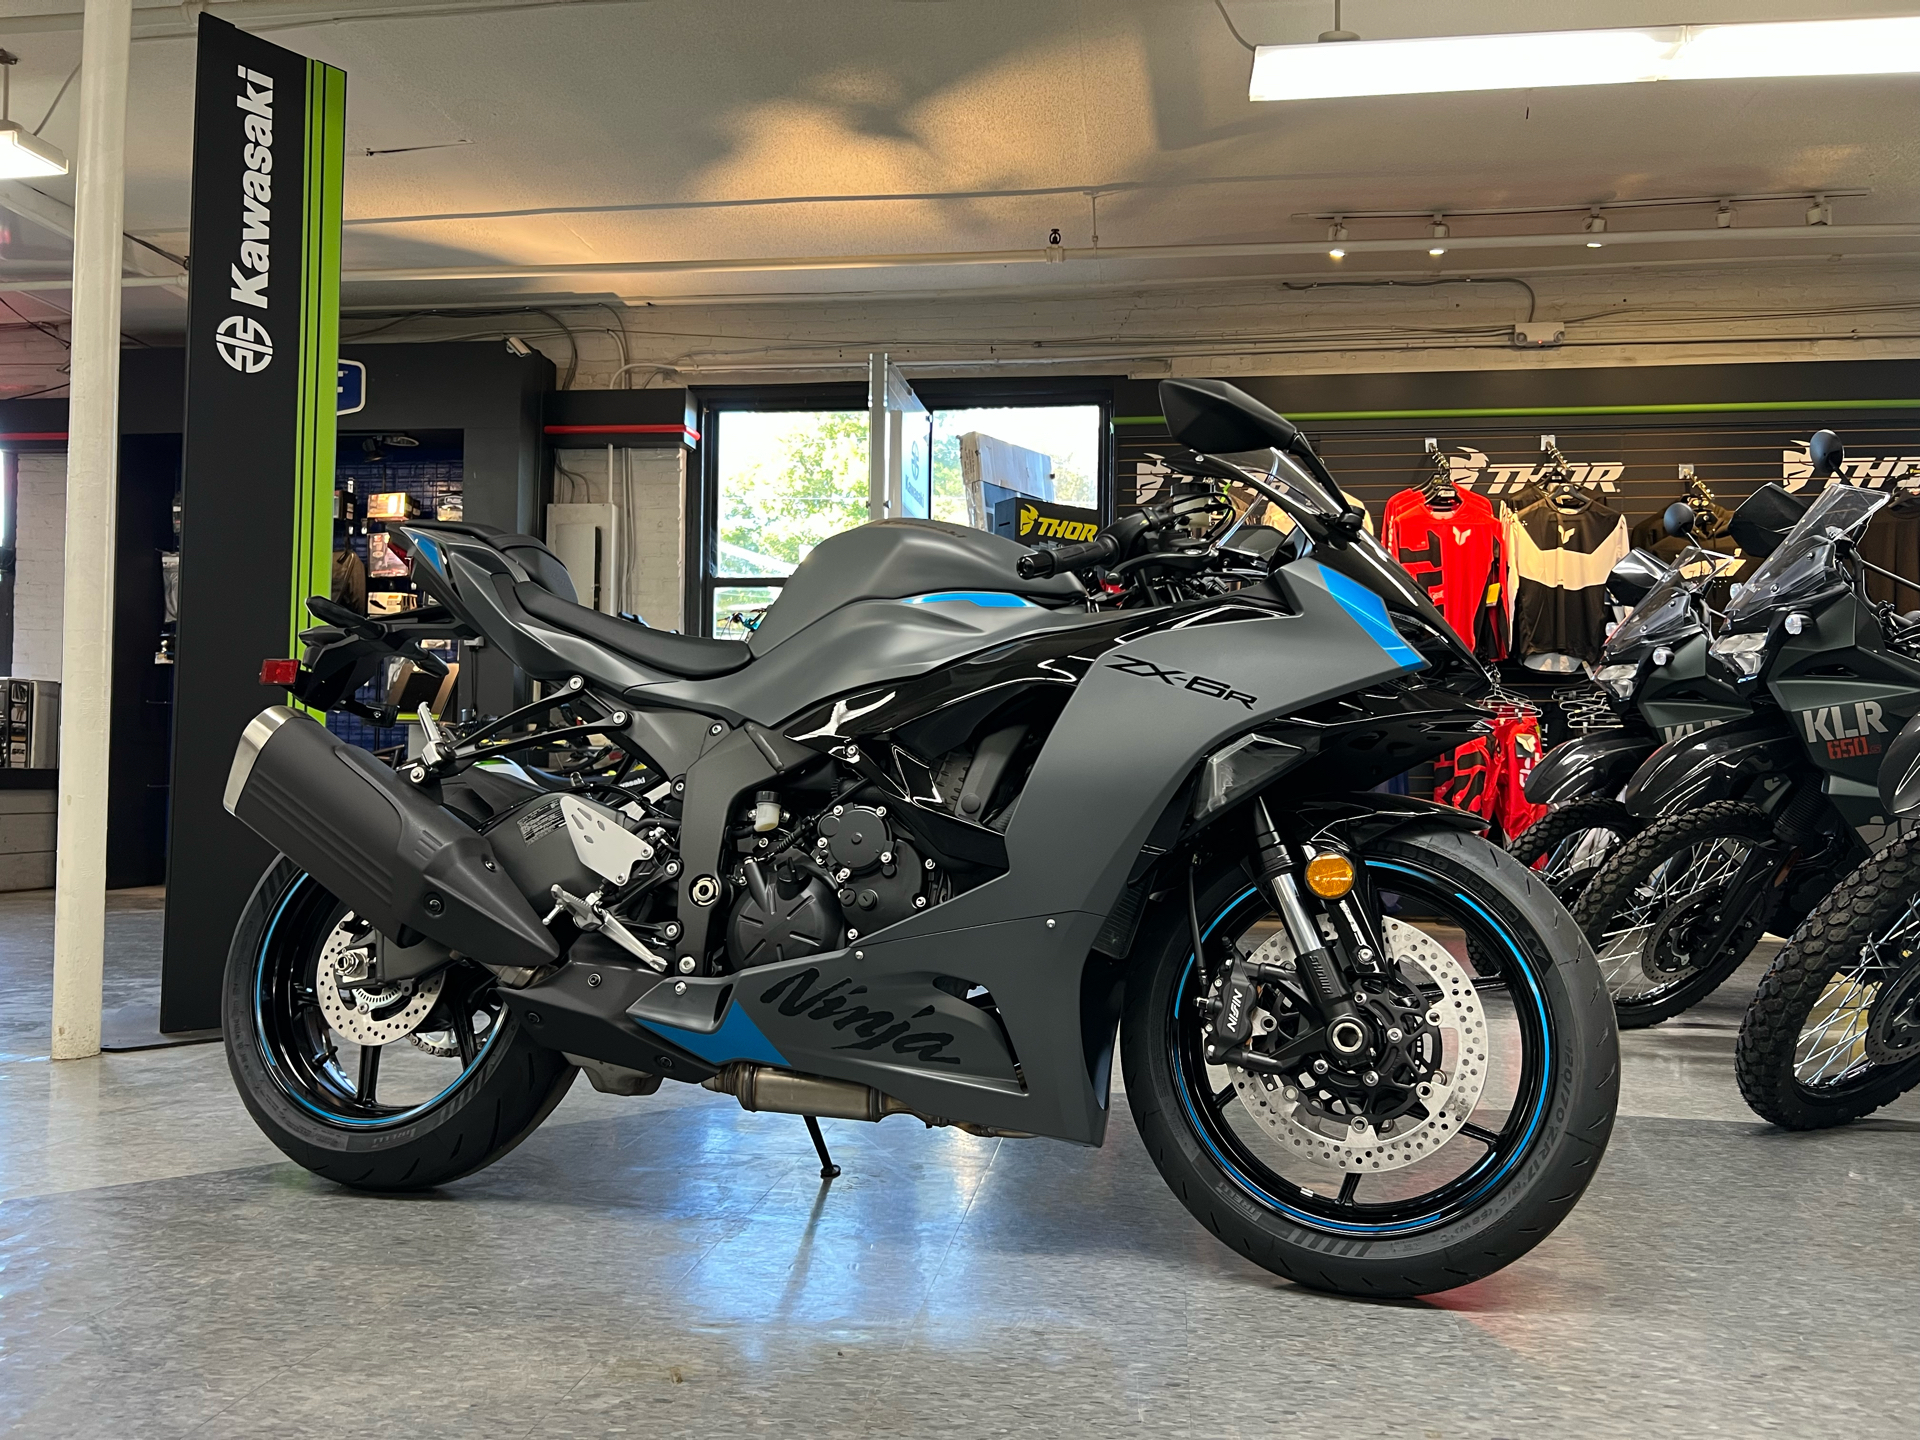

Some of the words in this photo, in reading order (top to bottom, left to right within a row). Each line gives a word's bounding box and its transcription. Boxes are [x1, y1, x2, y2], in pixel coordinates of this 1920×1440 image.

[231, 64, 274, 310] Kawasaki
[1037, 516, 1099, 543] THOR
[1103, 654, 1258, 711] ZX-6R
[1802, 701, 1889, 743] KLR
[1826, 736, 1868, 760] 650
[759, 967, 961, 1064] Ninja
